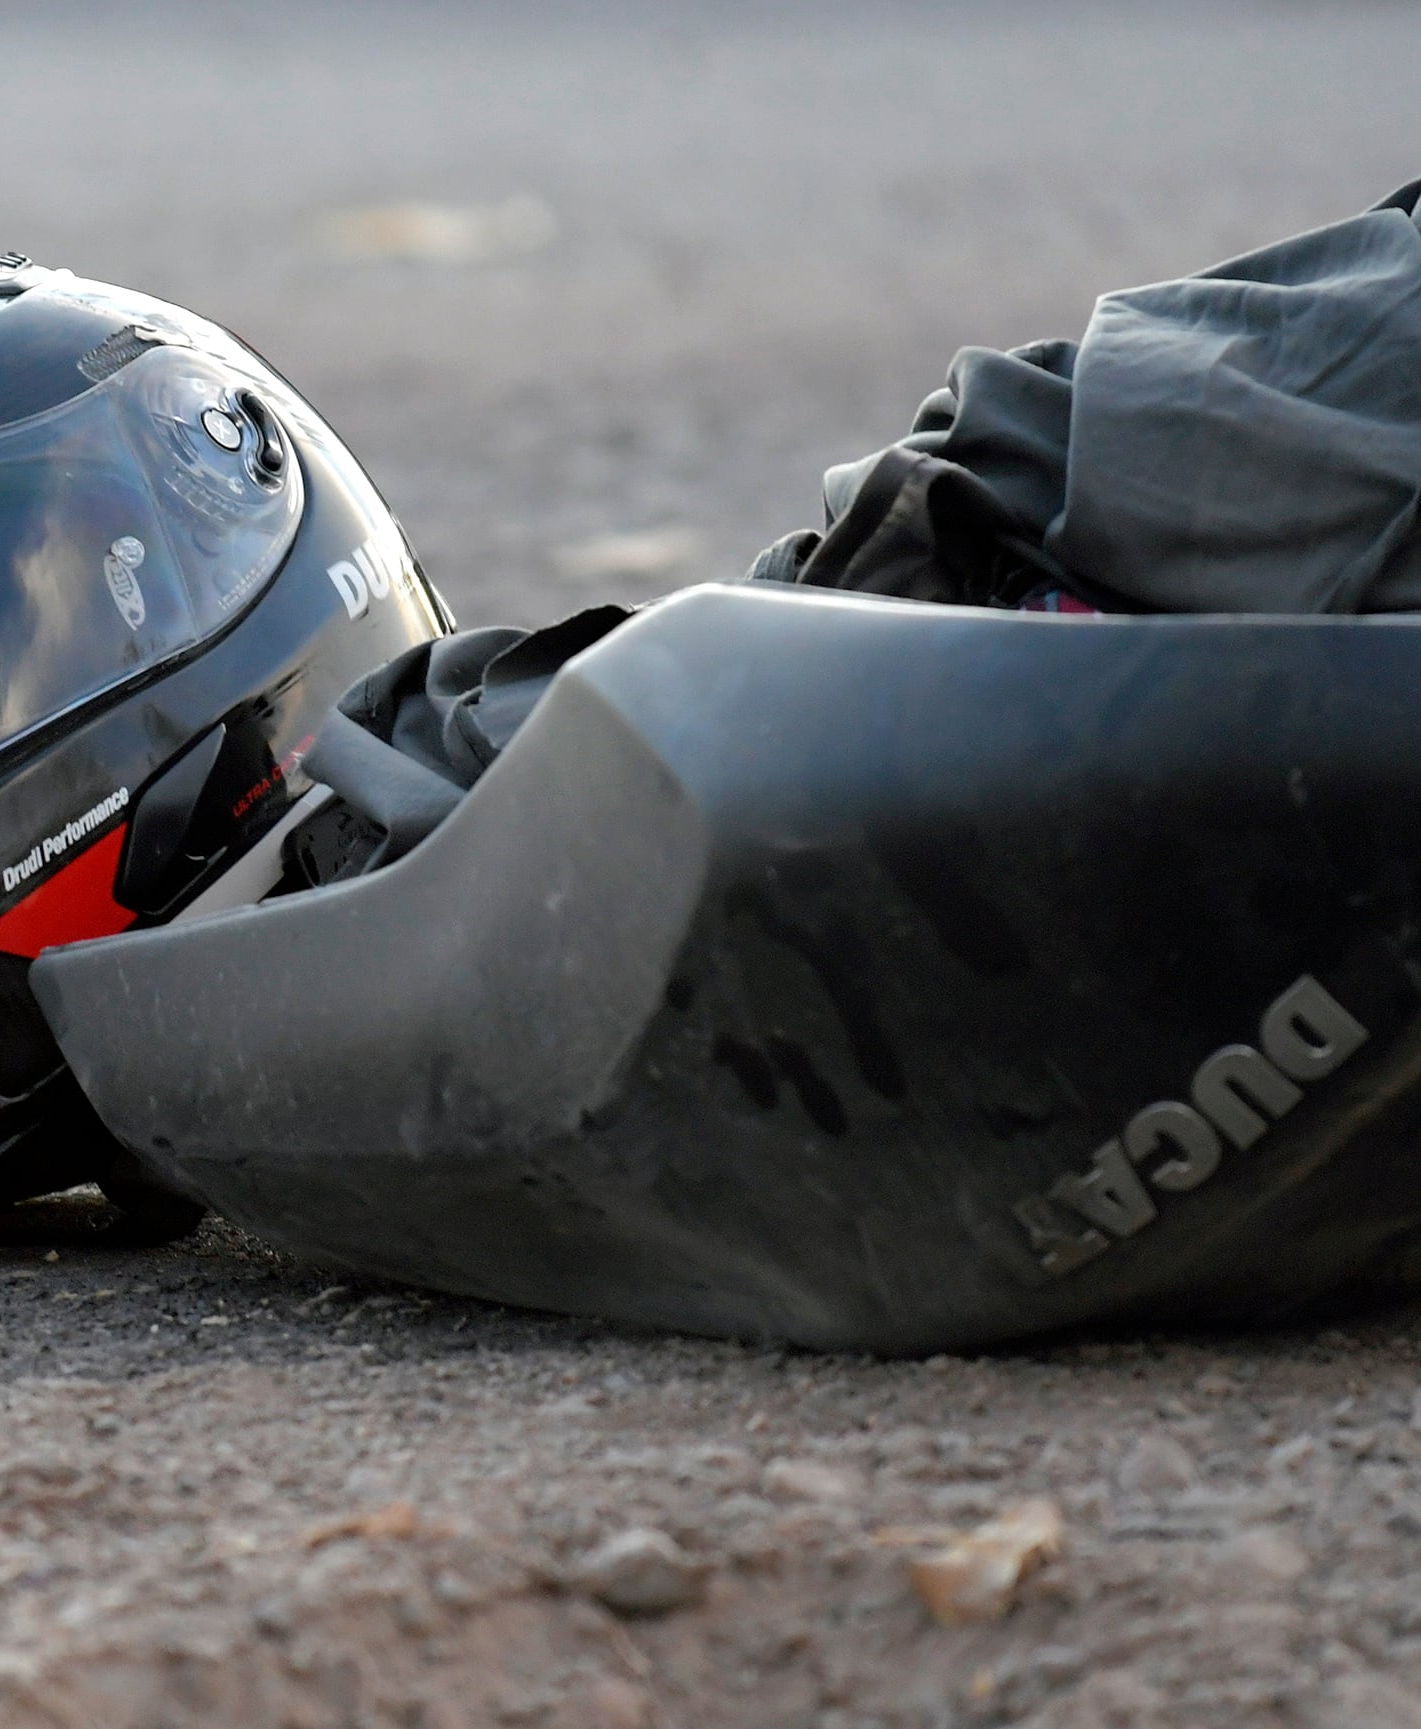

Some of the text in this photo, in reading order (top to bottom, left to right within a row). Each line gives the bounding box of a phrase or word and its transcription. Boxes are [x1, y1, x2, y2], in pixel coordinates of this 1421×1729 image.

[232, 777, 271, 818] ULTRA
[2, 786, 129, 891] Drudi Performance
